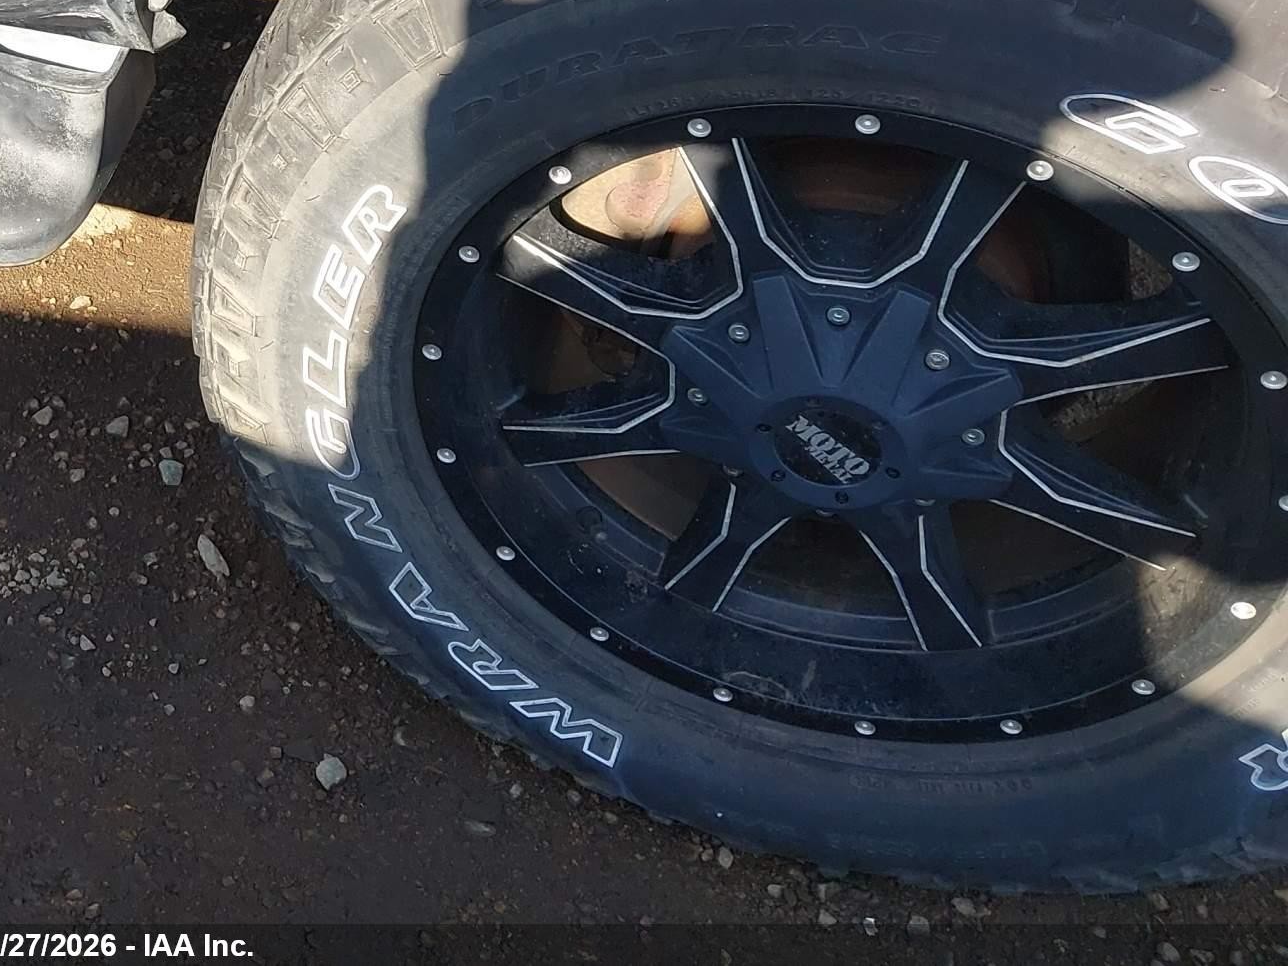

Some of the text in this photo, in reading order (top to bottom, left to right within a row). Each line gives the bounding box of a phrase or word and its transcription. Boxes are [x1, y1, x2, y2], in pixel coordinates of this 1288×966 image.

[452, 23, 944, 133] DURATRAC
[302, 184, 623, 768] WRANGLER
[785, 415, 870, 476] MOTO
[802, 442, 853, 484] METAL
